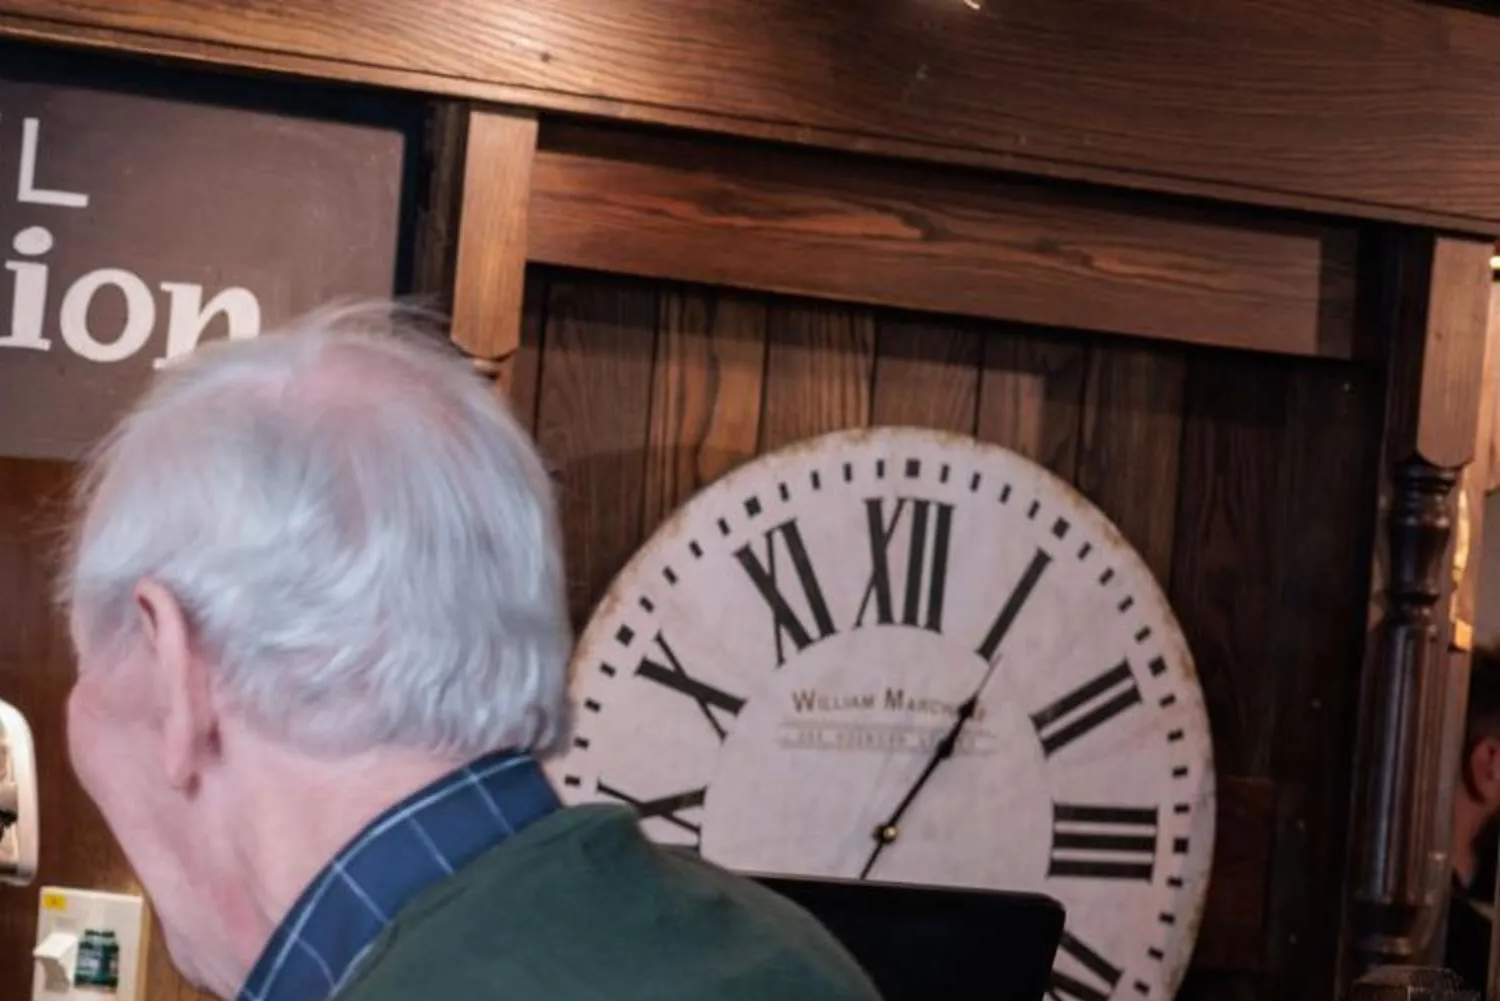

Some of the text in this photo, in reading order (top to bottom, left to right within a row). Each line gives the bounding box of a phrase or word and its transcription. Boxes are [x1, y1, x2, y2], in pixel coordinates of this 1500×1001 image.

[732, 517, 839, 668] XI
[854, 496, 954, 634] XII
[633, 629, 747, 745] X
